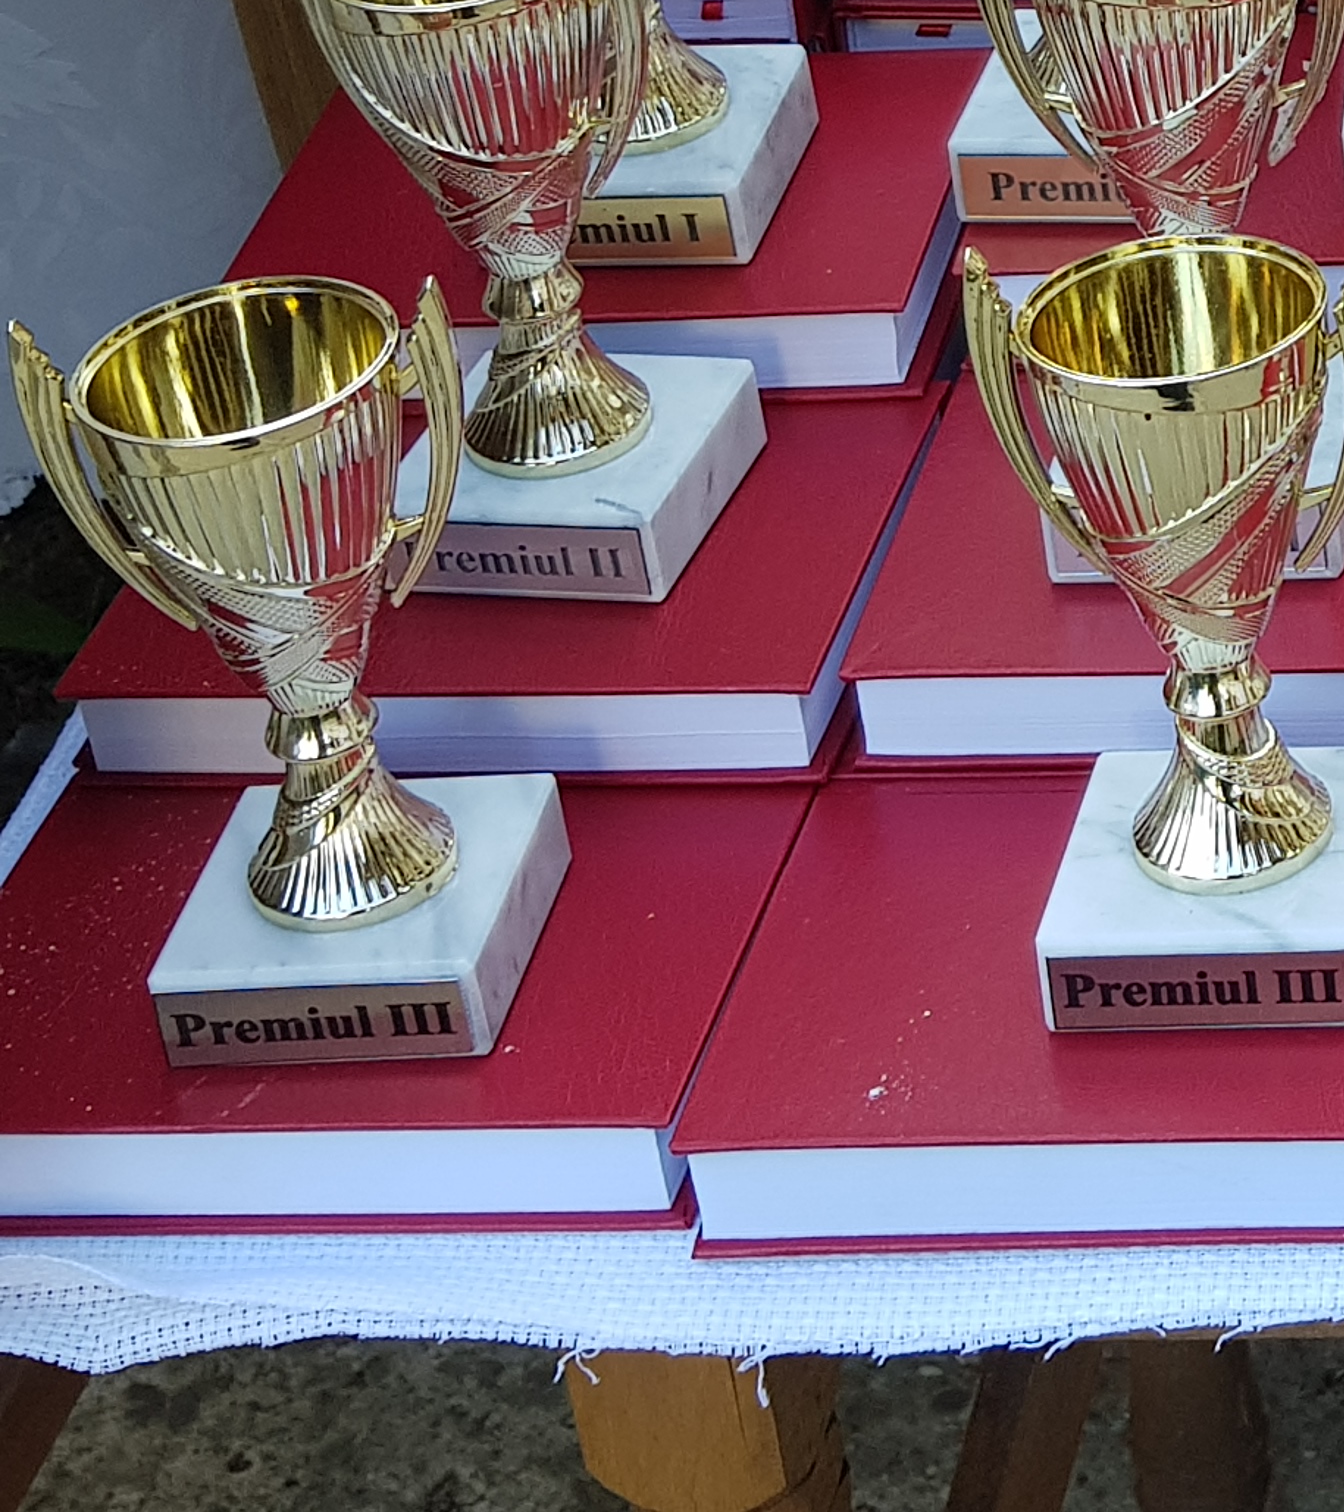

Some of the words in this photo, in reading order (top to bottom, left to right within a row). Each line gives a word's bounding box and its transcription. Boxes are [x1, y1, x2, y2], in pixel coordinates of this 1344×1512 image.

[988, 171, 1126, 203] Premi
[576, 214, 672, 245] miul
[681, 212, 700, 242] I
[588, 547, 626, 578] II
[1060, 969, 1262, 1009] Premiul
[1272, 968, 1343, 1004] III
[170, 1005, 375, 1047] Premiul
[385, 1001, 458, 1037] III
